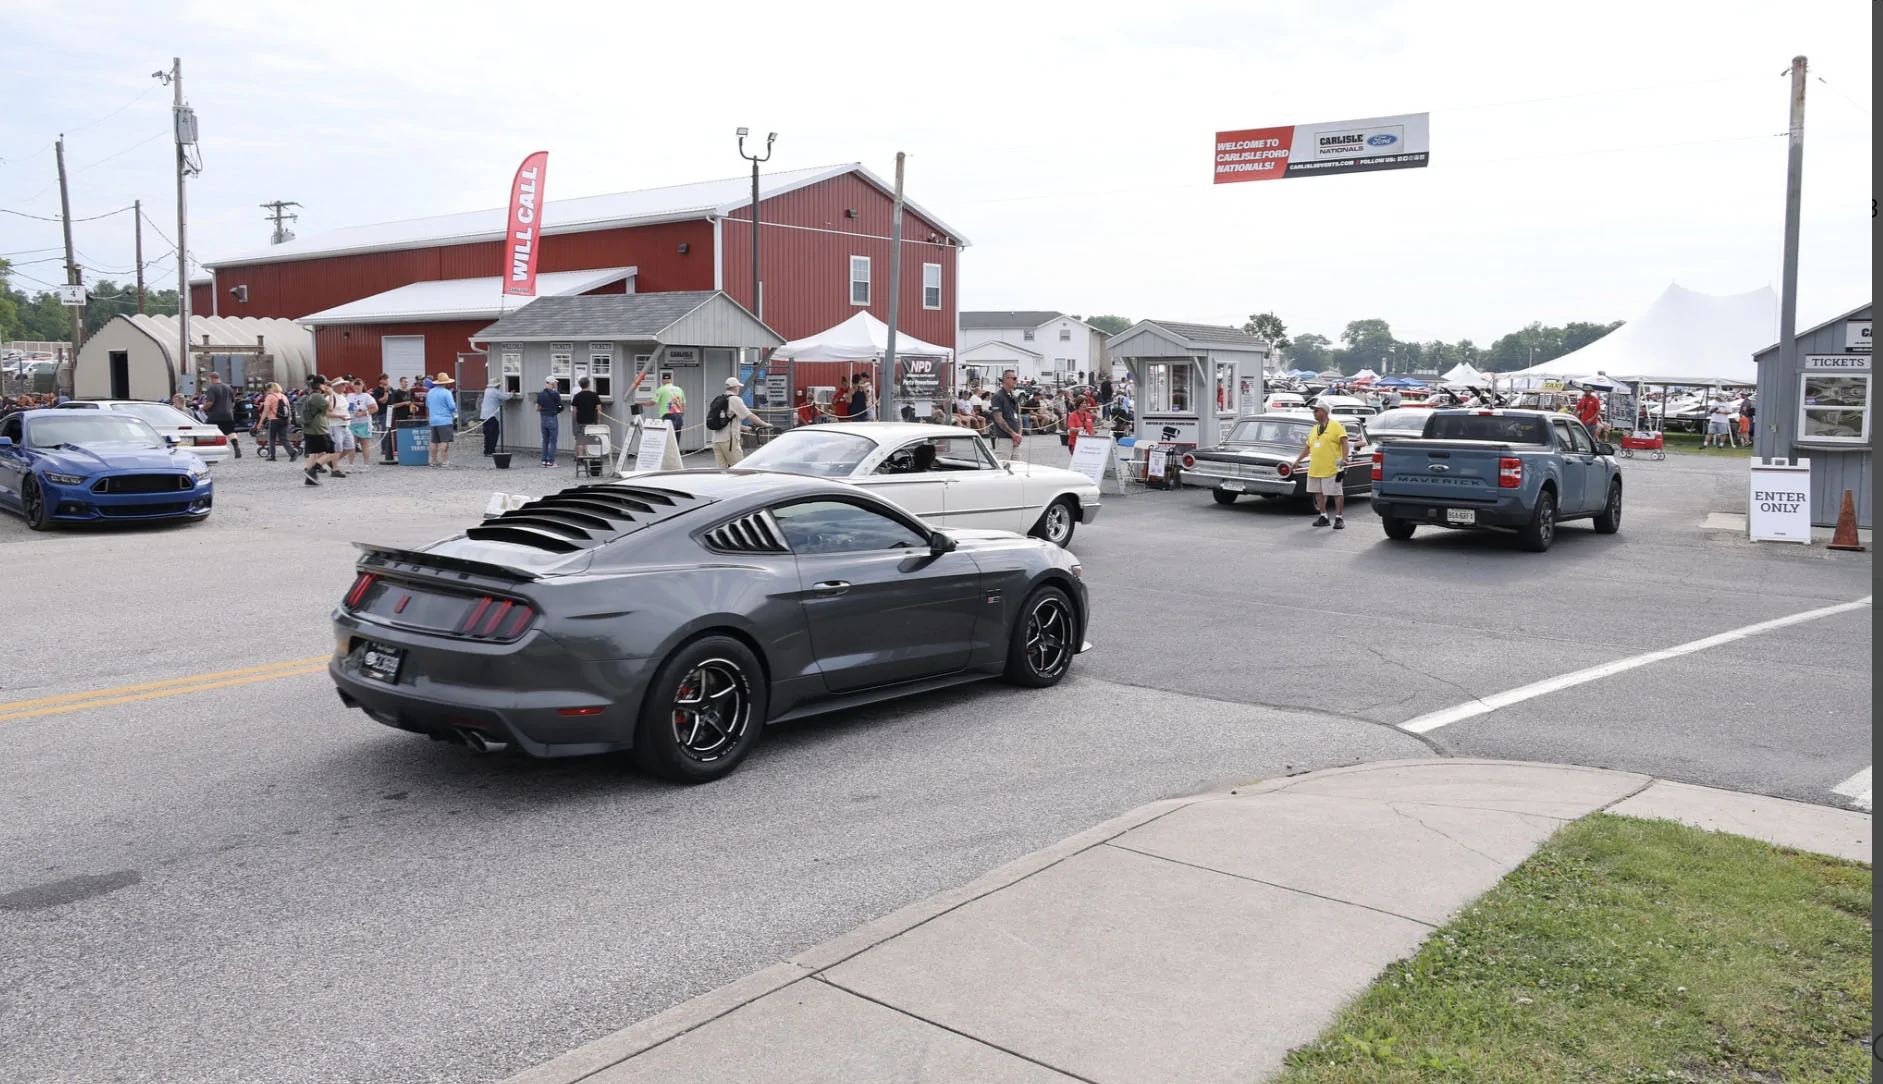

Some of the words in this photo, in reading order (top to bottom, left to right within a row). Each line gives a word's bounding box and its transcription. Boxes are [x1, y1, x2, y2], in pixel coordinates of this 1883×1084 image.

[1217, 140, 1265, 151] WELCOME
[1265, 138, 1280, 147] TO
[1319, 134, 1364, 146] CARLISLE
[1372, 135, 1392, 145] Ford
[1217, 151, 1262, 162] CARLISLE
[1262, 149, 1289, 159] FORD
[1319, 146, 1364, 155] NATIONALS
[1216, 161, 1275, 173] NATIONALS!
[518, 167, 537, 224] CALL
[512, 228, 532, 282] WILL
[911, 360, 932, 373] NPD
[1811, 358, 1865, 367] TICKETS
[1397, 476, 1481, 486] MAVERICK
[1755, 491, 1806, 502] ENTER
[1760, 502, 1800, 513] ONLY
